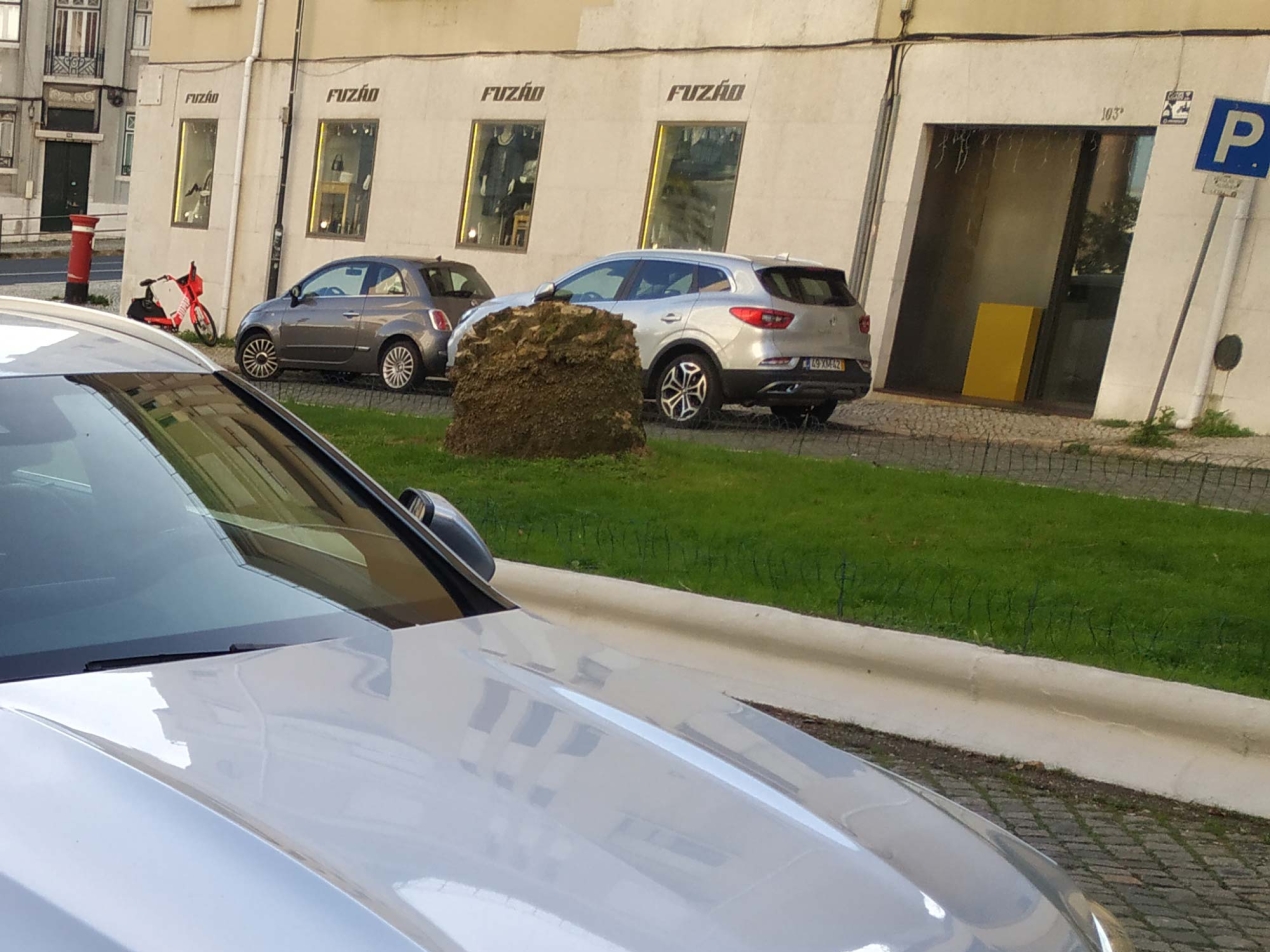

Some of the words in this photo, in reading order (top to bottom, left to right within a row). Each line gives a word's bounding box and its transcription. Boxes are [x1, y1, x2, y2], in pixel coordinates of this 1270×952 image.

[326, 84, 380, 102] FUZÃO
[480, 81, 546, 102] FUZÃO
[666, 79, 746, 102] FUZÃO
[1213, 109, 1265, 163] P
